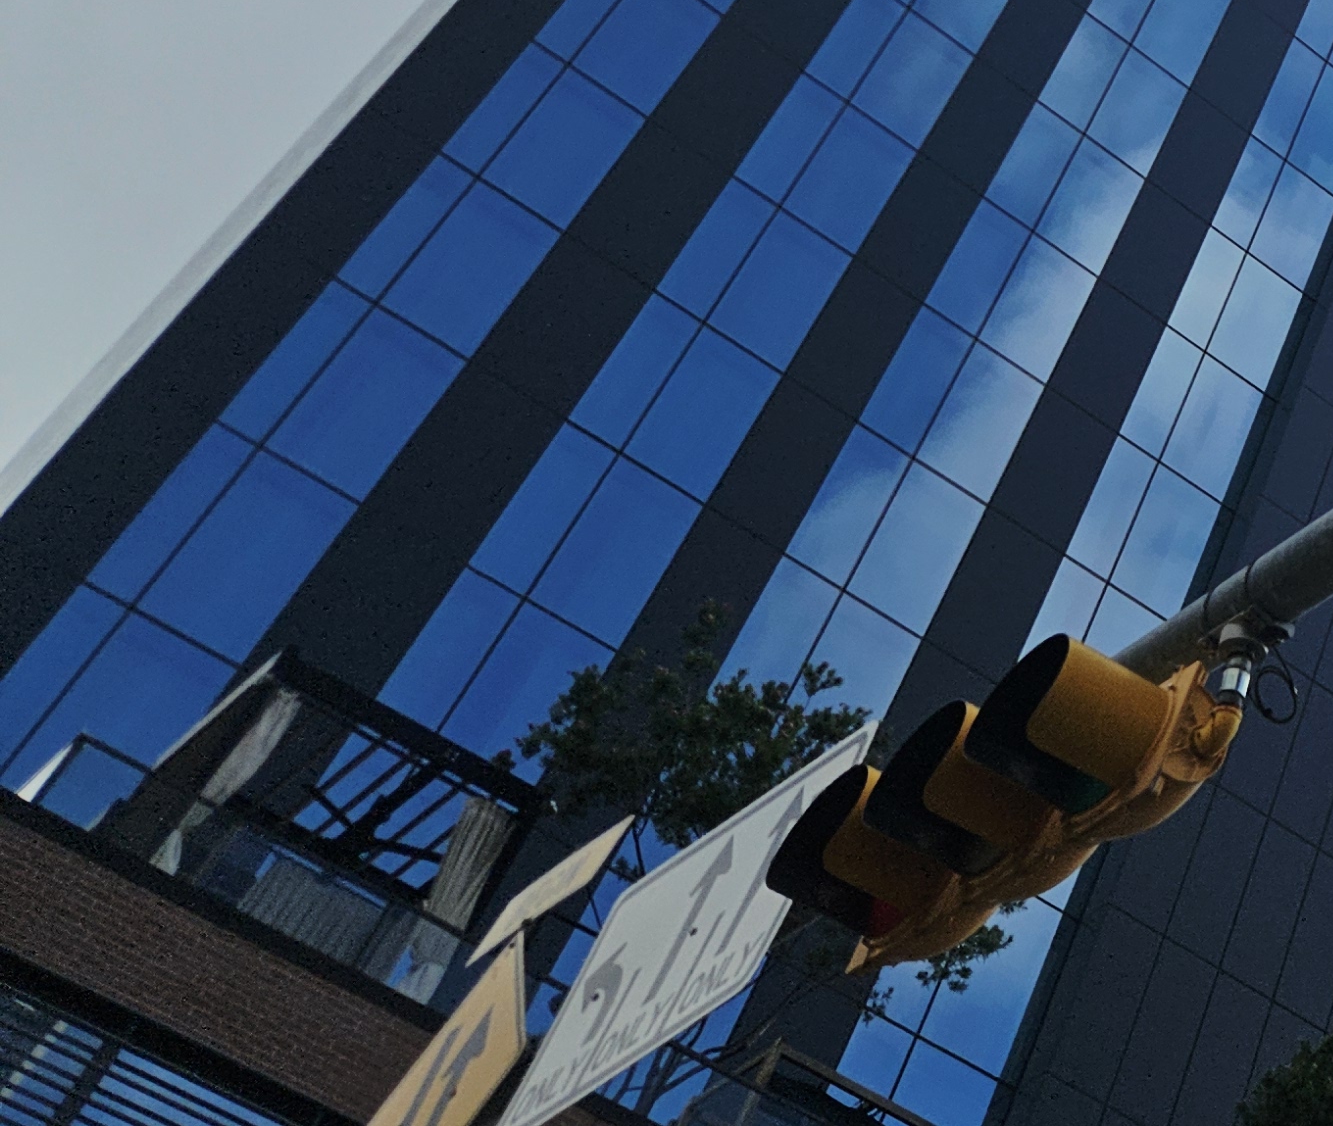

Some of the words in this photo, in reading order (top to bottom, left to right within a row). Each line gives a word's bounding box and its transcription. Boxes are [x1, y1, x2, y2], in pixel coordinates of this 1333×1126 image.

[510, 1049, 592, 1123] ONLY
[591, 993, 675, 1071] ONLY
[678, 931, 766, 1014] ONLY
